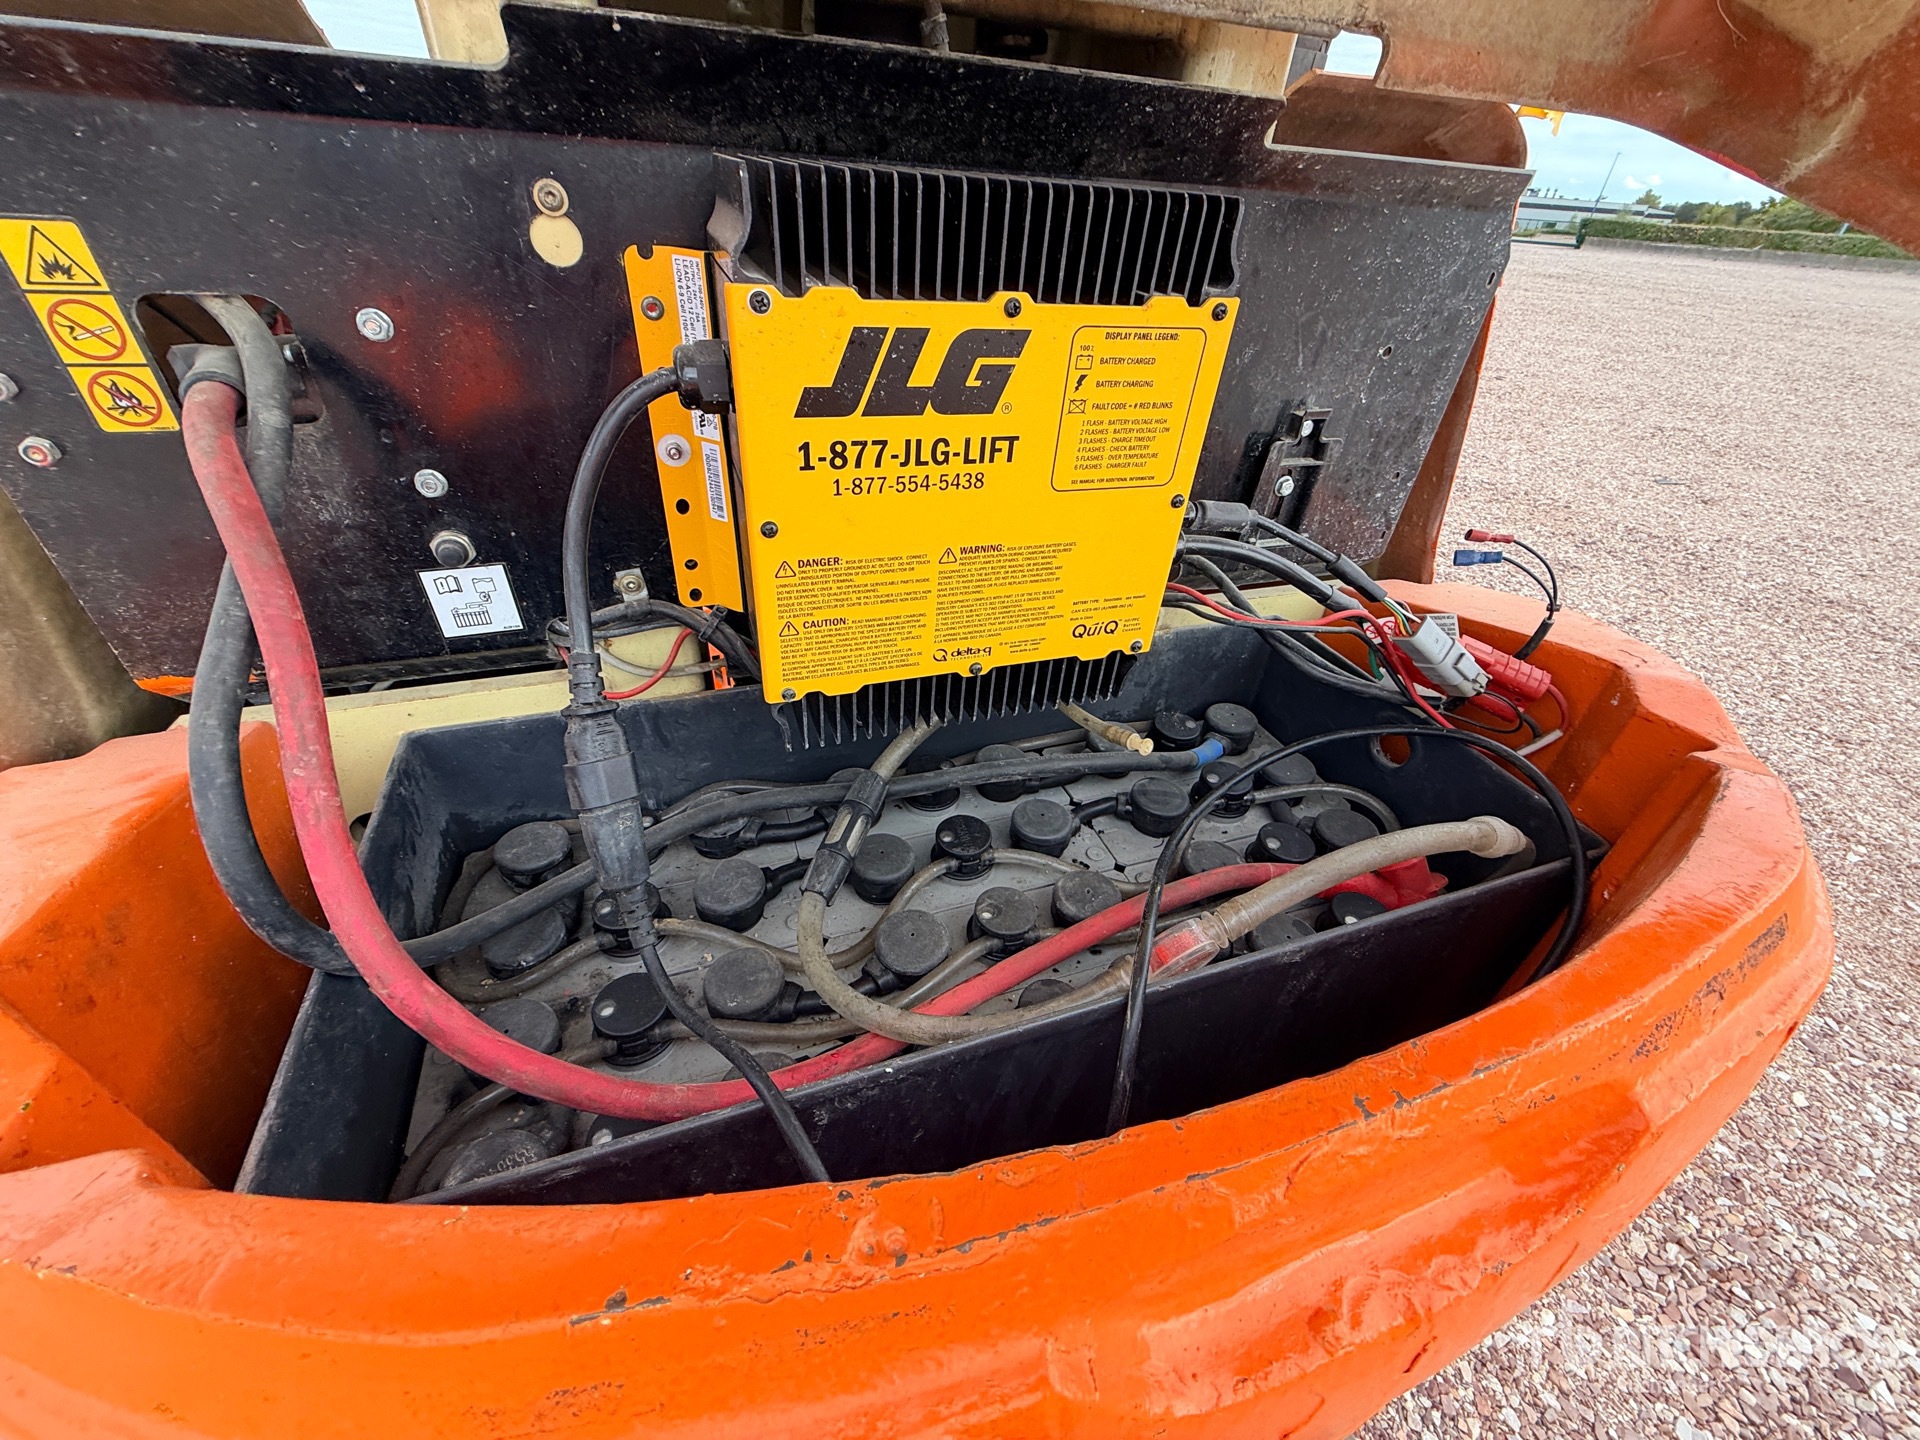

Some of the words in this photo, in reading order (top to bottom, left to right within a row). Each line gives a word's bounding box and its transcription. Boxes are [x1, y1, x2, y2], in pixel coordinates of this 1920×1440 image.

[674, 258, 682, 283] LI-ION
[682, 259, 692, 304] LEAD-ACID
[688, 306, 694, 315] 12
[1106, 332, 1132, 340] DISPLAY
[1133, 333, 1152, 341] PANEL
[1154, 333, 1180, 341] LEGEND:
[793, 326, 1032, 418] JLG
[798, 435, 1021, 471] 1-877-JLG-LIFT
[832, 472, 985, 496] 1-877-554-5438
[960, 544, 1005, 555] WARNING:
[798, 557, 843, 568] DANGER:
[803, 617, 849, 630] CAUTION:
[950, 646, 992, 657] delta-q
